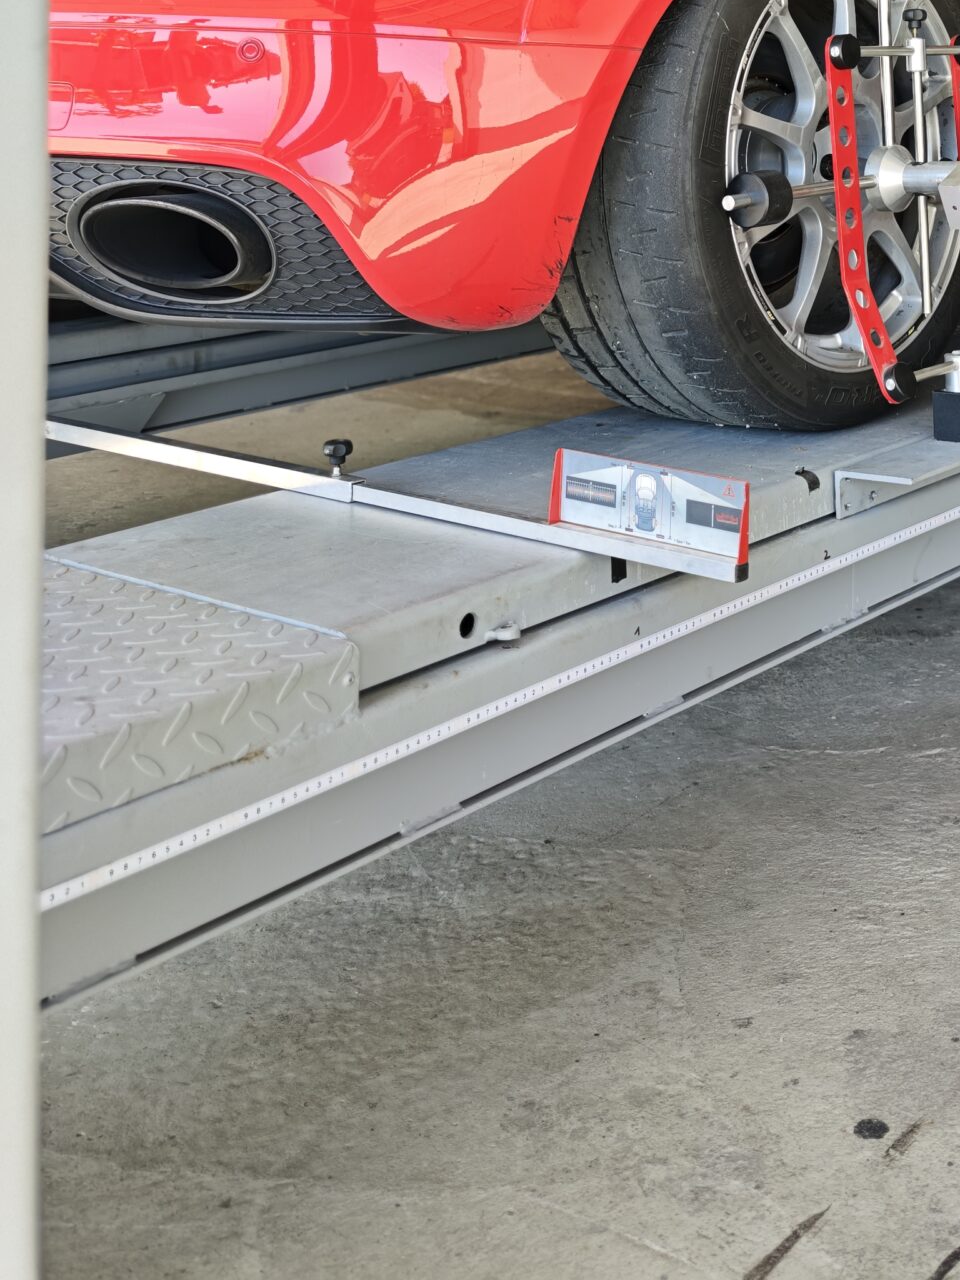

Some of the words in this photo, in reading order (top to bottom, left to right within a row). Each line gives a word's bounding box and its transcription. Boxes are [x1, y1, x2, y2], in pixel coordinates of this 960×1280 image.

[823, 549, 831, 561] 2
[49, 893, 55, 902] 3
[64, 887, 71, 896] 2
[109, 868, 115, 877] 9
[123, 863, 129, 871] 8
[138, 856, 142, 865] 7
[151, 851, 157, 859] 6
[165, 845, 170, 853] 5
[192, 833, 198, 842] 3
[205, 828, 210, 837] 2
